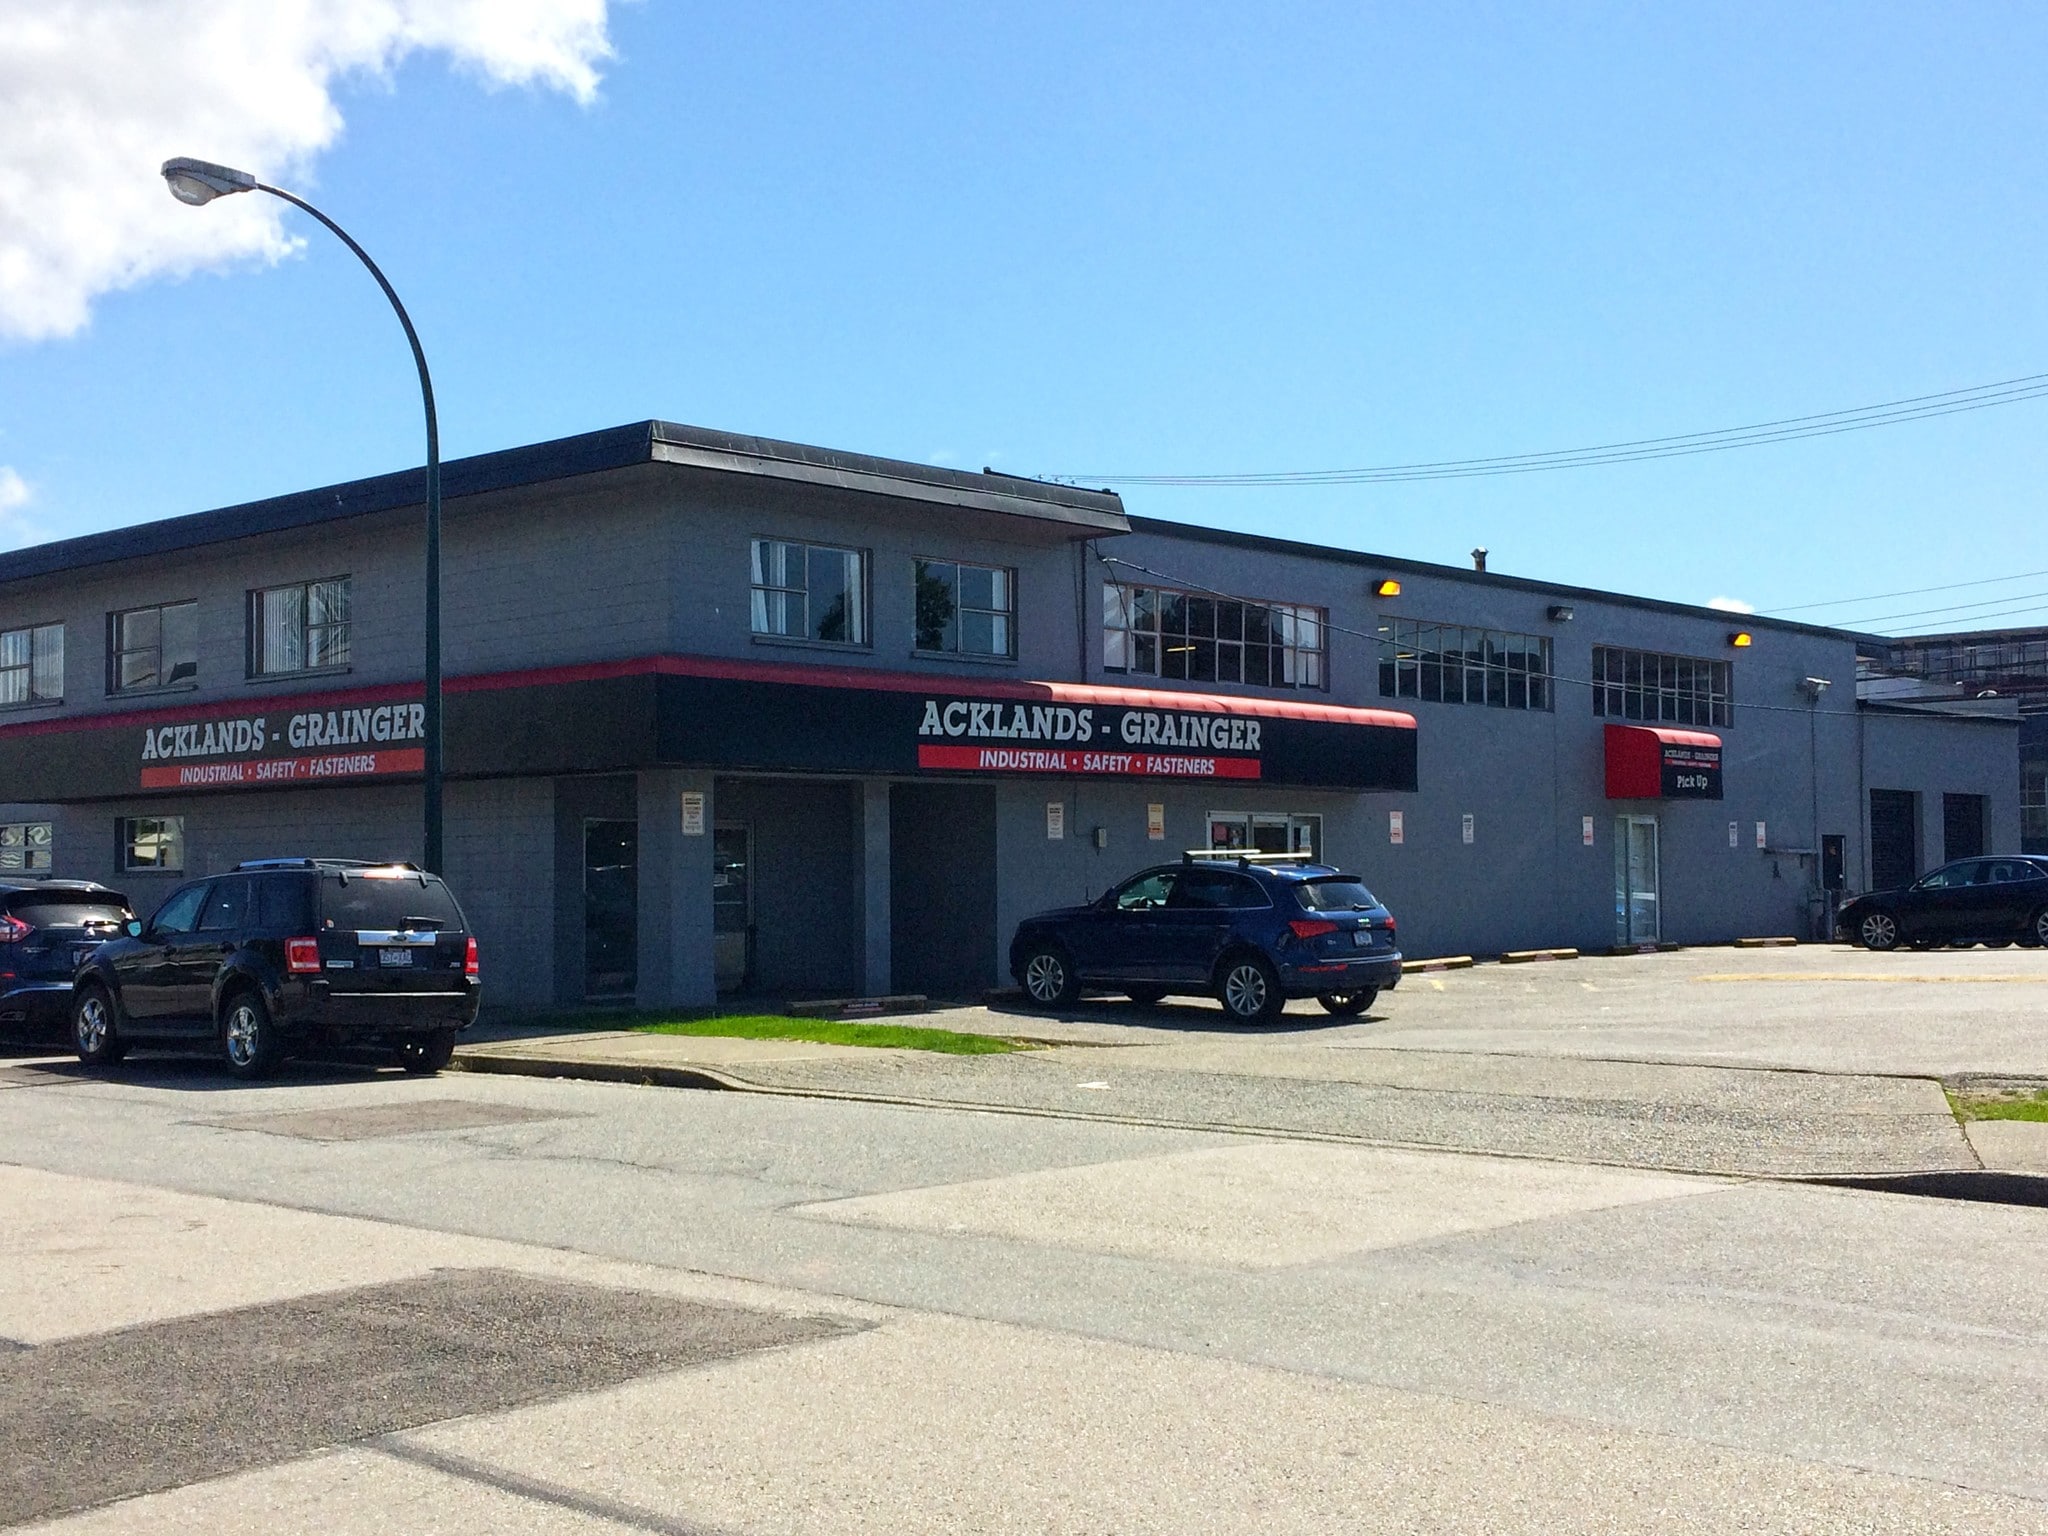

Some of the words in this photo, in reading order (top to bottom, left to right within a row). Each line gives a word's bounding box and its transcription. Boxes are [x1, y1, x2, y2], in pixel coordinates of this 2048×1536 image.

[142, 717, 265, 760] ACKLANDS
[288, 703, 425, 748] GRAINGER
[919, 701, 1093, 742] ACKLANDS
[1121, 711, 1261, 750] GRAINGER
[180, 764, 244, 784] INDUSTRIAL
[256, 760, 297, 780] SAFETY
[309, 754, 376, 776] FASTENERS
[979, 750, 1067, 770] INDUSTRIAL
[1083, 753, 1132, 771] SAFETY
[1147, 756, 1215, 775] FASTENERS
[1677, 775, 1695, 788] Pick
[1696, 775, 1708, 789] Up
